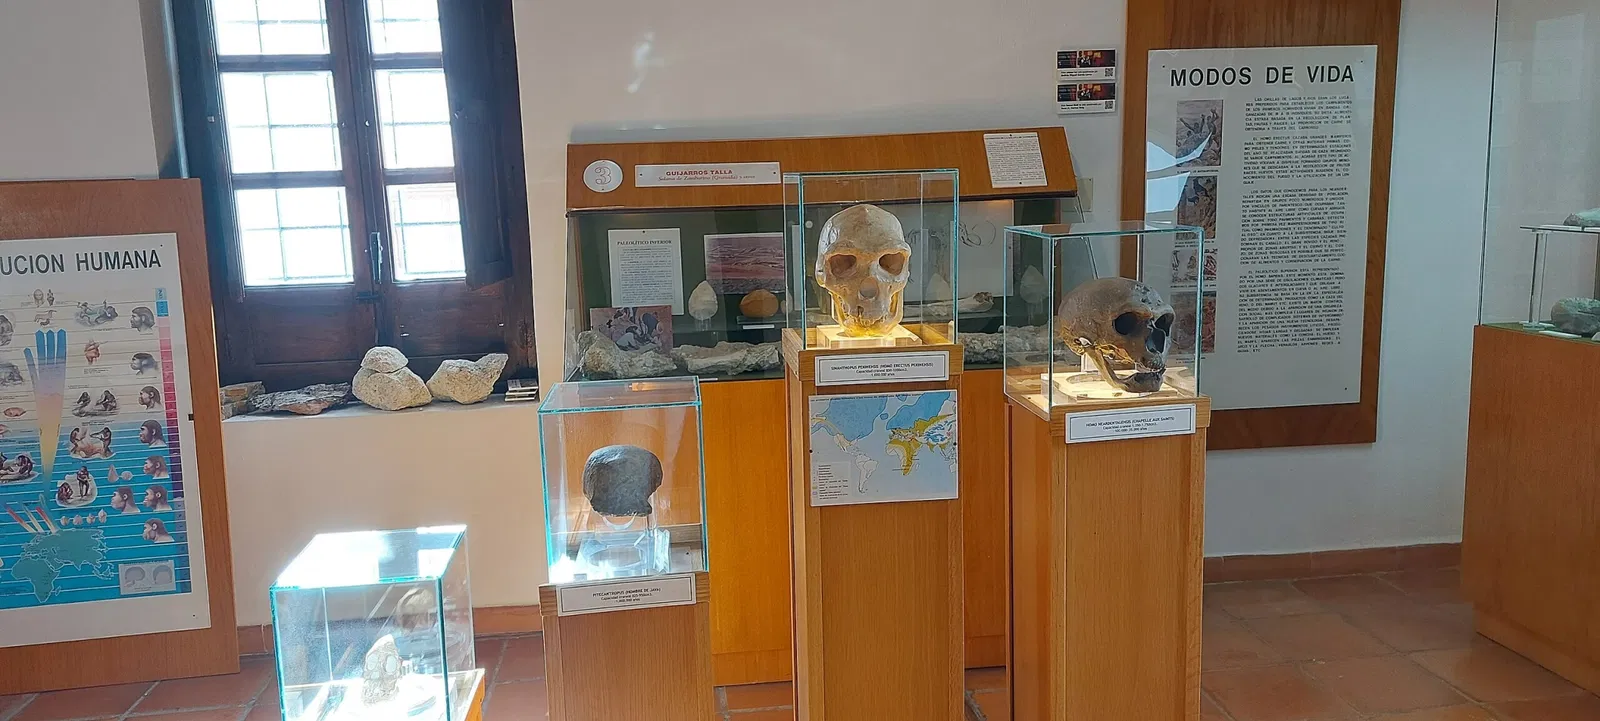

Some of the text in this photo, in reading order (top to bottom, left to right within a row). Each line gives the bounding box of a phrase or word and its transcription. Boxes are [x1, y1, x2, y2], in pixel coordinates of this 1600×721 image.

[1170, 66, 1354, 86] MODOS DE VIDA
[595, 166, 611, 184] 3
[0, 250, 161, 275] UCION HUMANA
